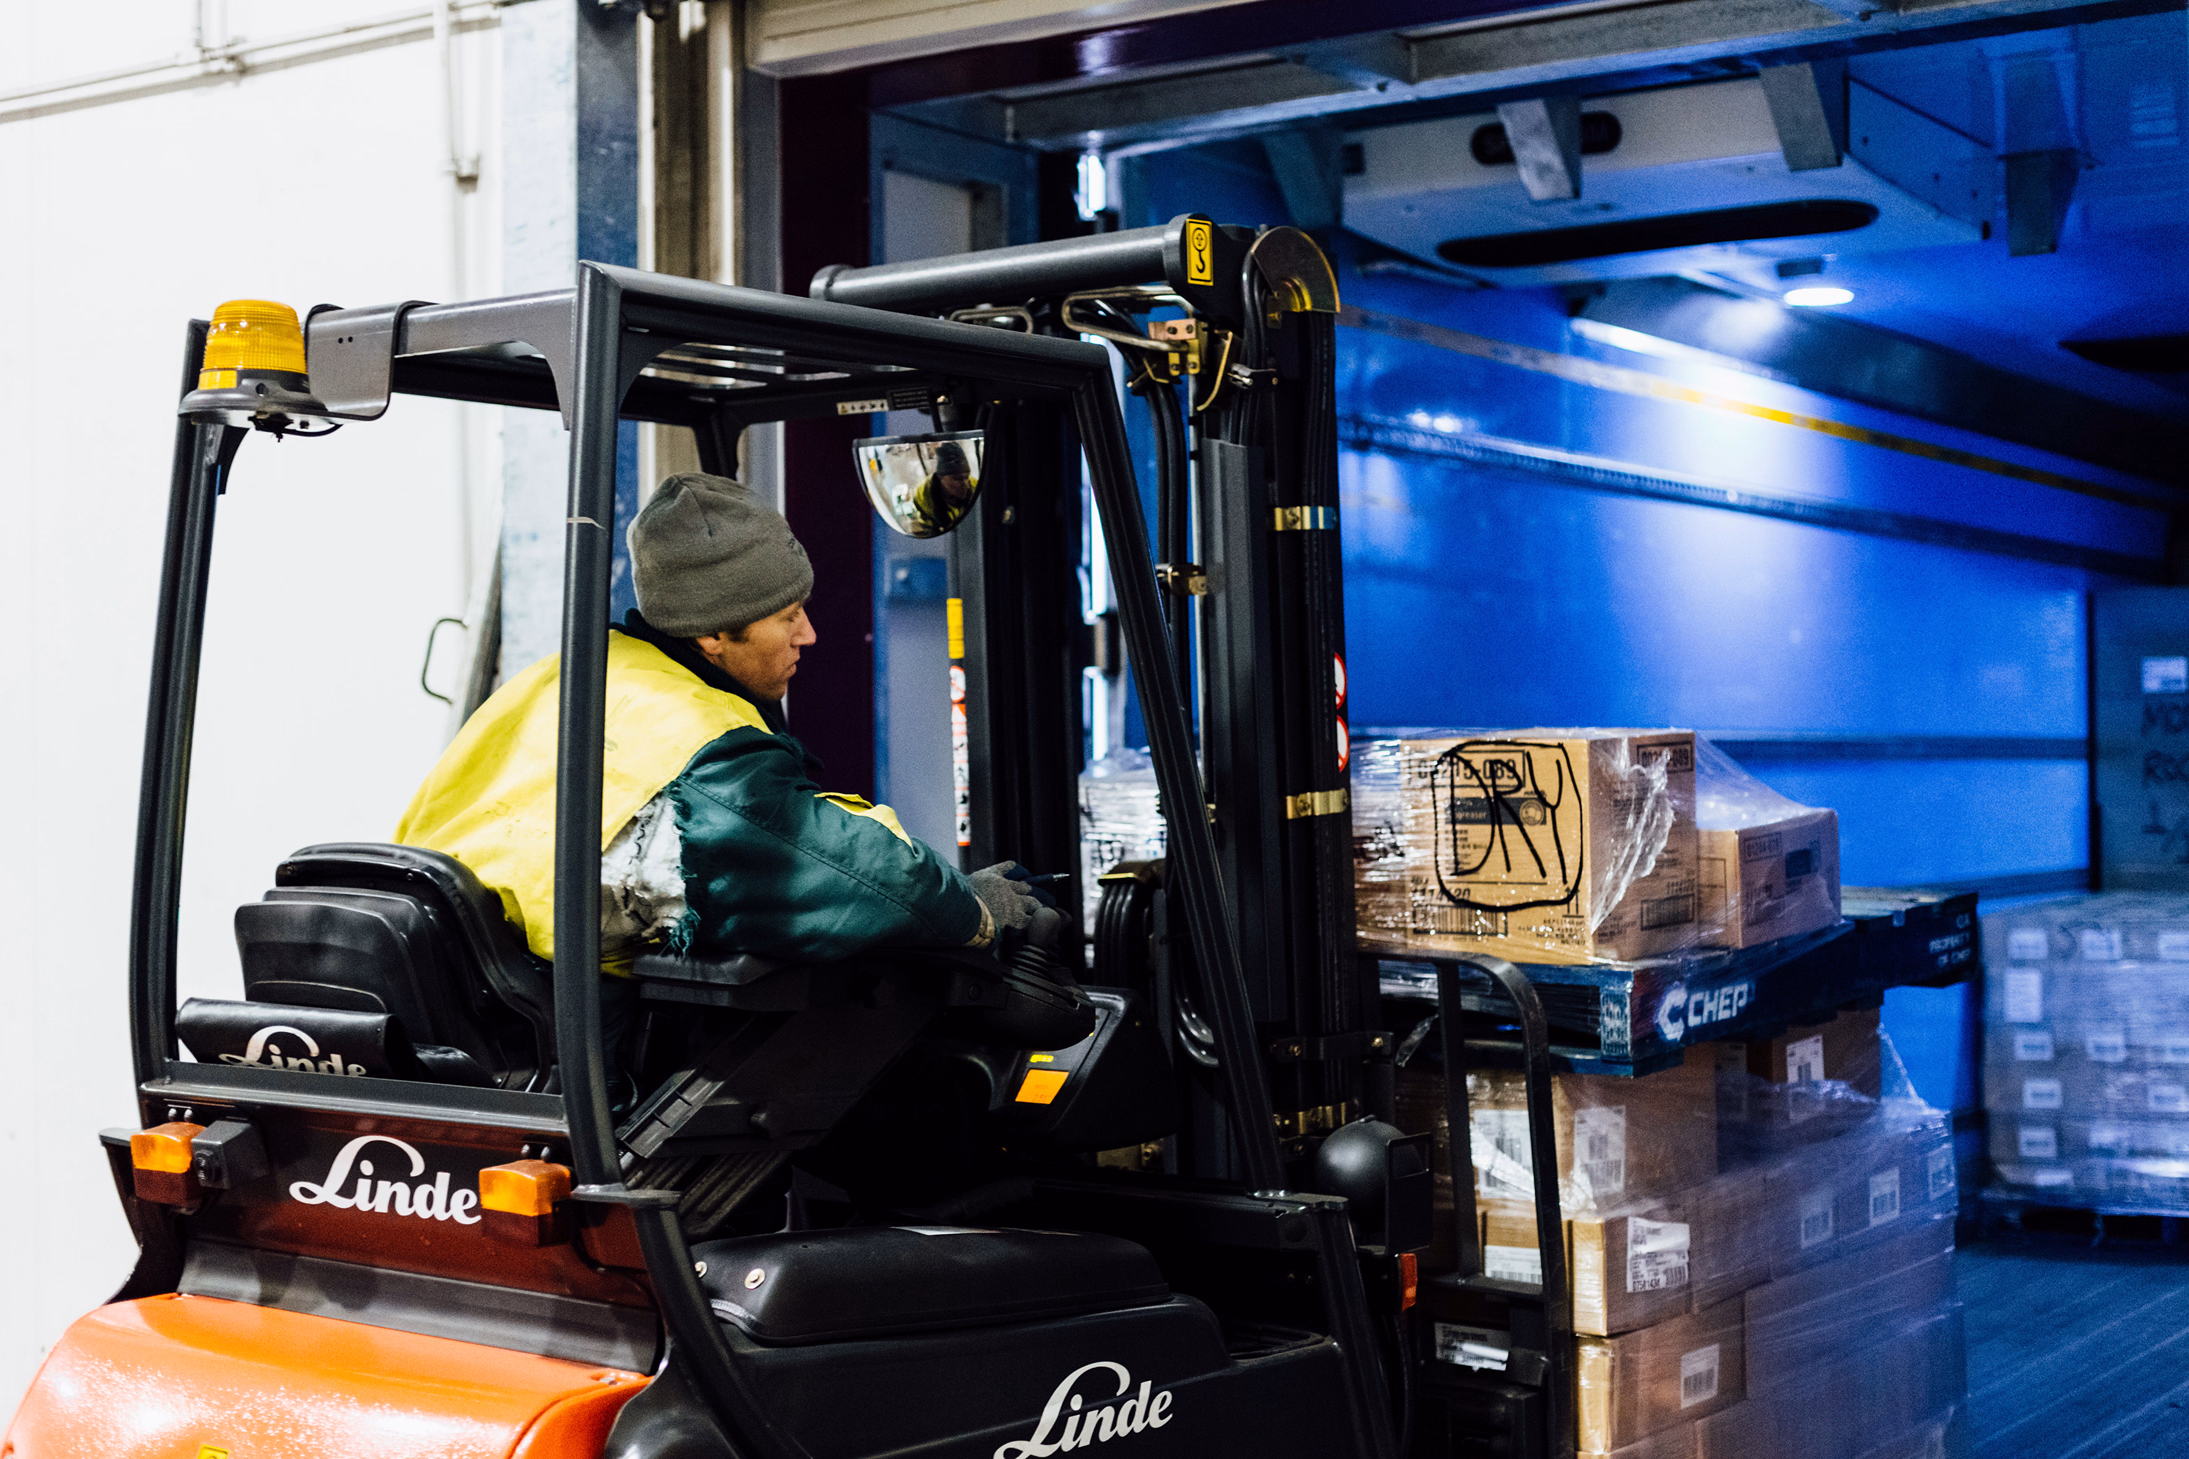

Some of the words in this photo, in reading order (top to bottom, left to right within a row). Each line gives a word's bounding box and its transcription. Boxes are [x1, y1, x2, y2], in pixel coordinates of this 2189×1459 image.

[1449, 751, 1568, 885] DRY
[1687, 983, 1749, 1028] CHEP
[288, 1135, 483, 1225] Linde
[993, 1361, 1174, 1459] Linde
